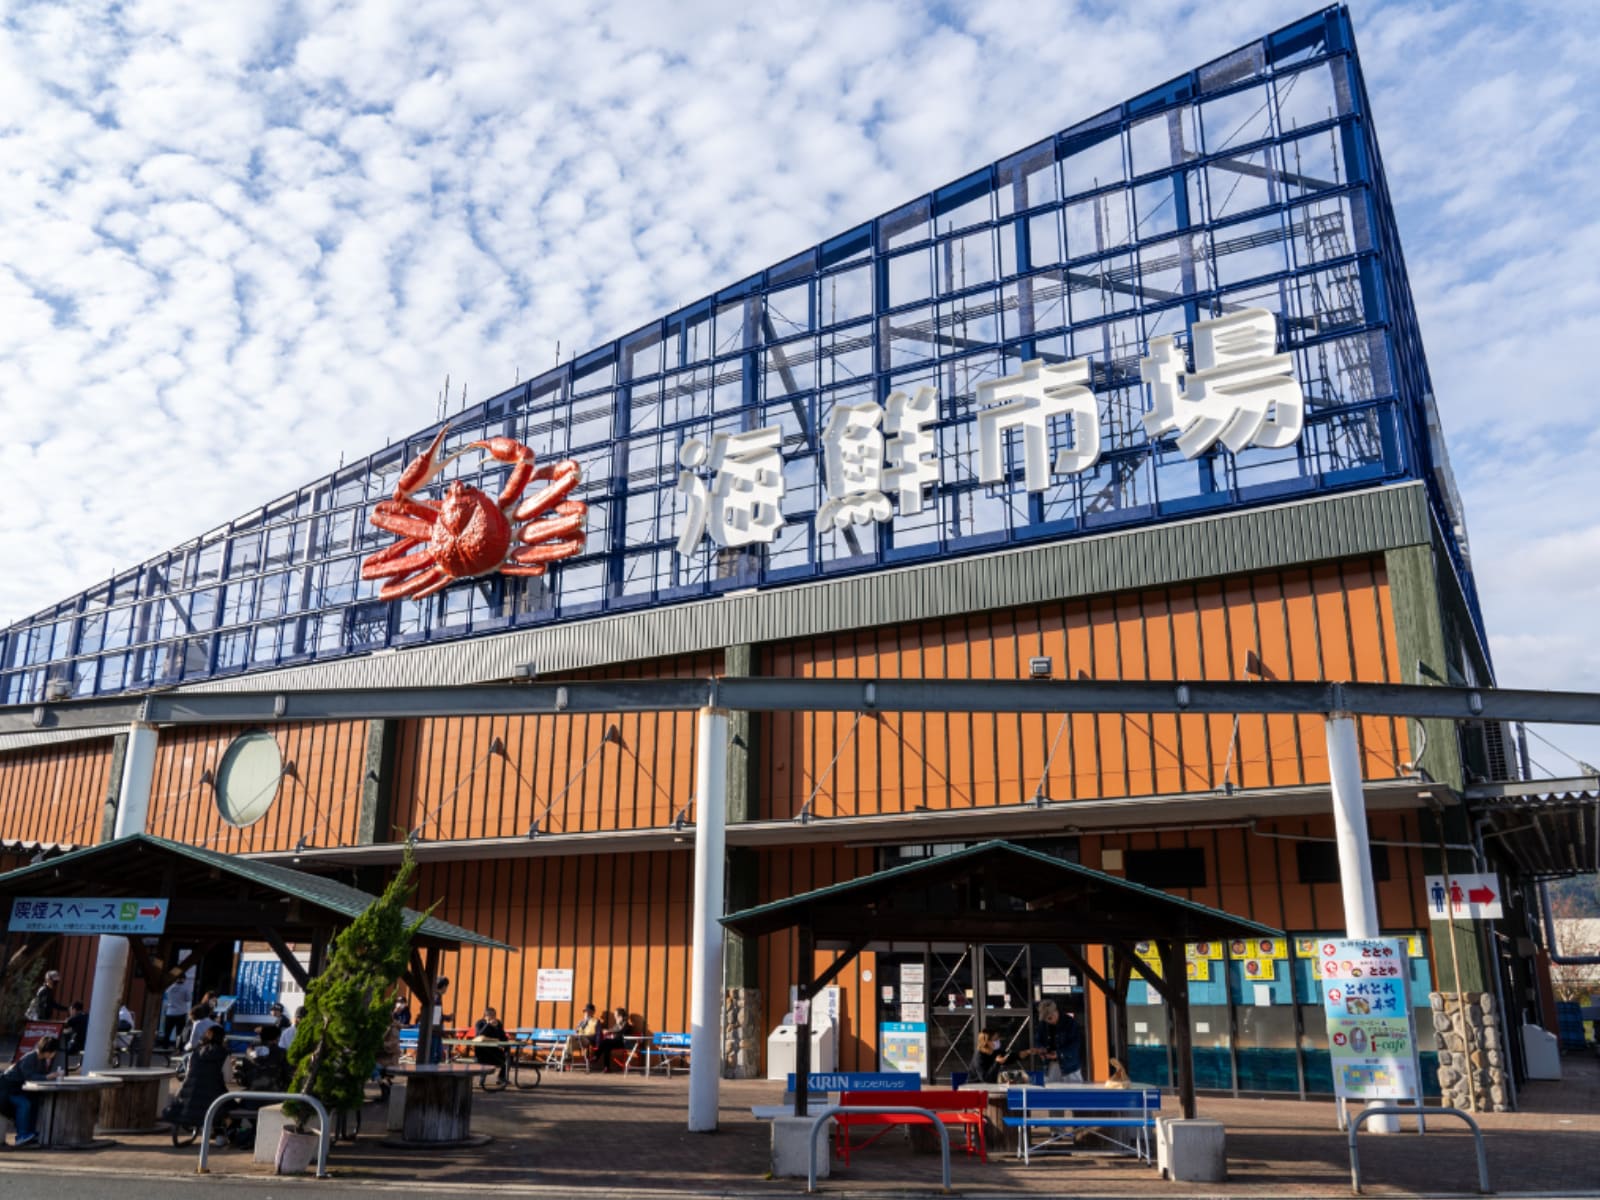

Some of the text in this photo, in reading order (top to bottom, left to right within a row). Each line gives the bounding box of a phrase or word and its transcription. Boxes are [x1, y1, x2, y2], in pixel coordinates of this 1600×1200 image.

[677, 308, 1304, 557] 海鮮市場
[15, 901, 116, 919] 喫煙スペース
[1362, 948, 1393, 957] ととや
[1370, 967, 1397, 976] ととや
[1345, 982, 1396, 995] とれとれ
[807, 1075, 849, 1090] KIRIN
